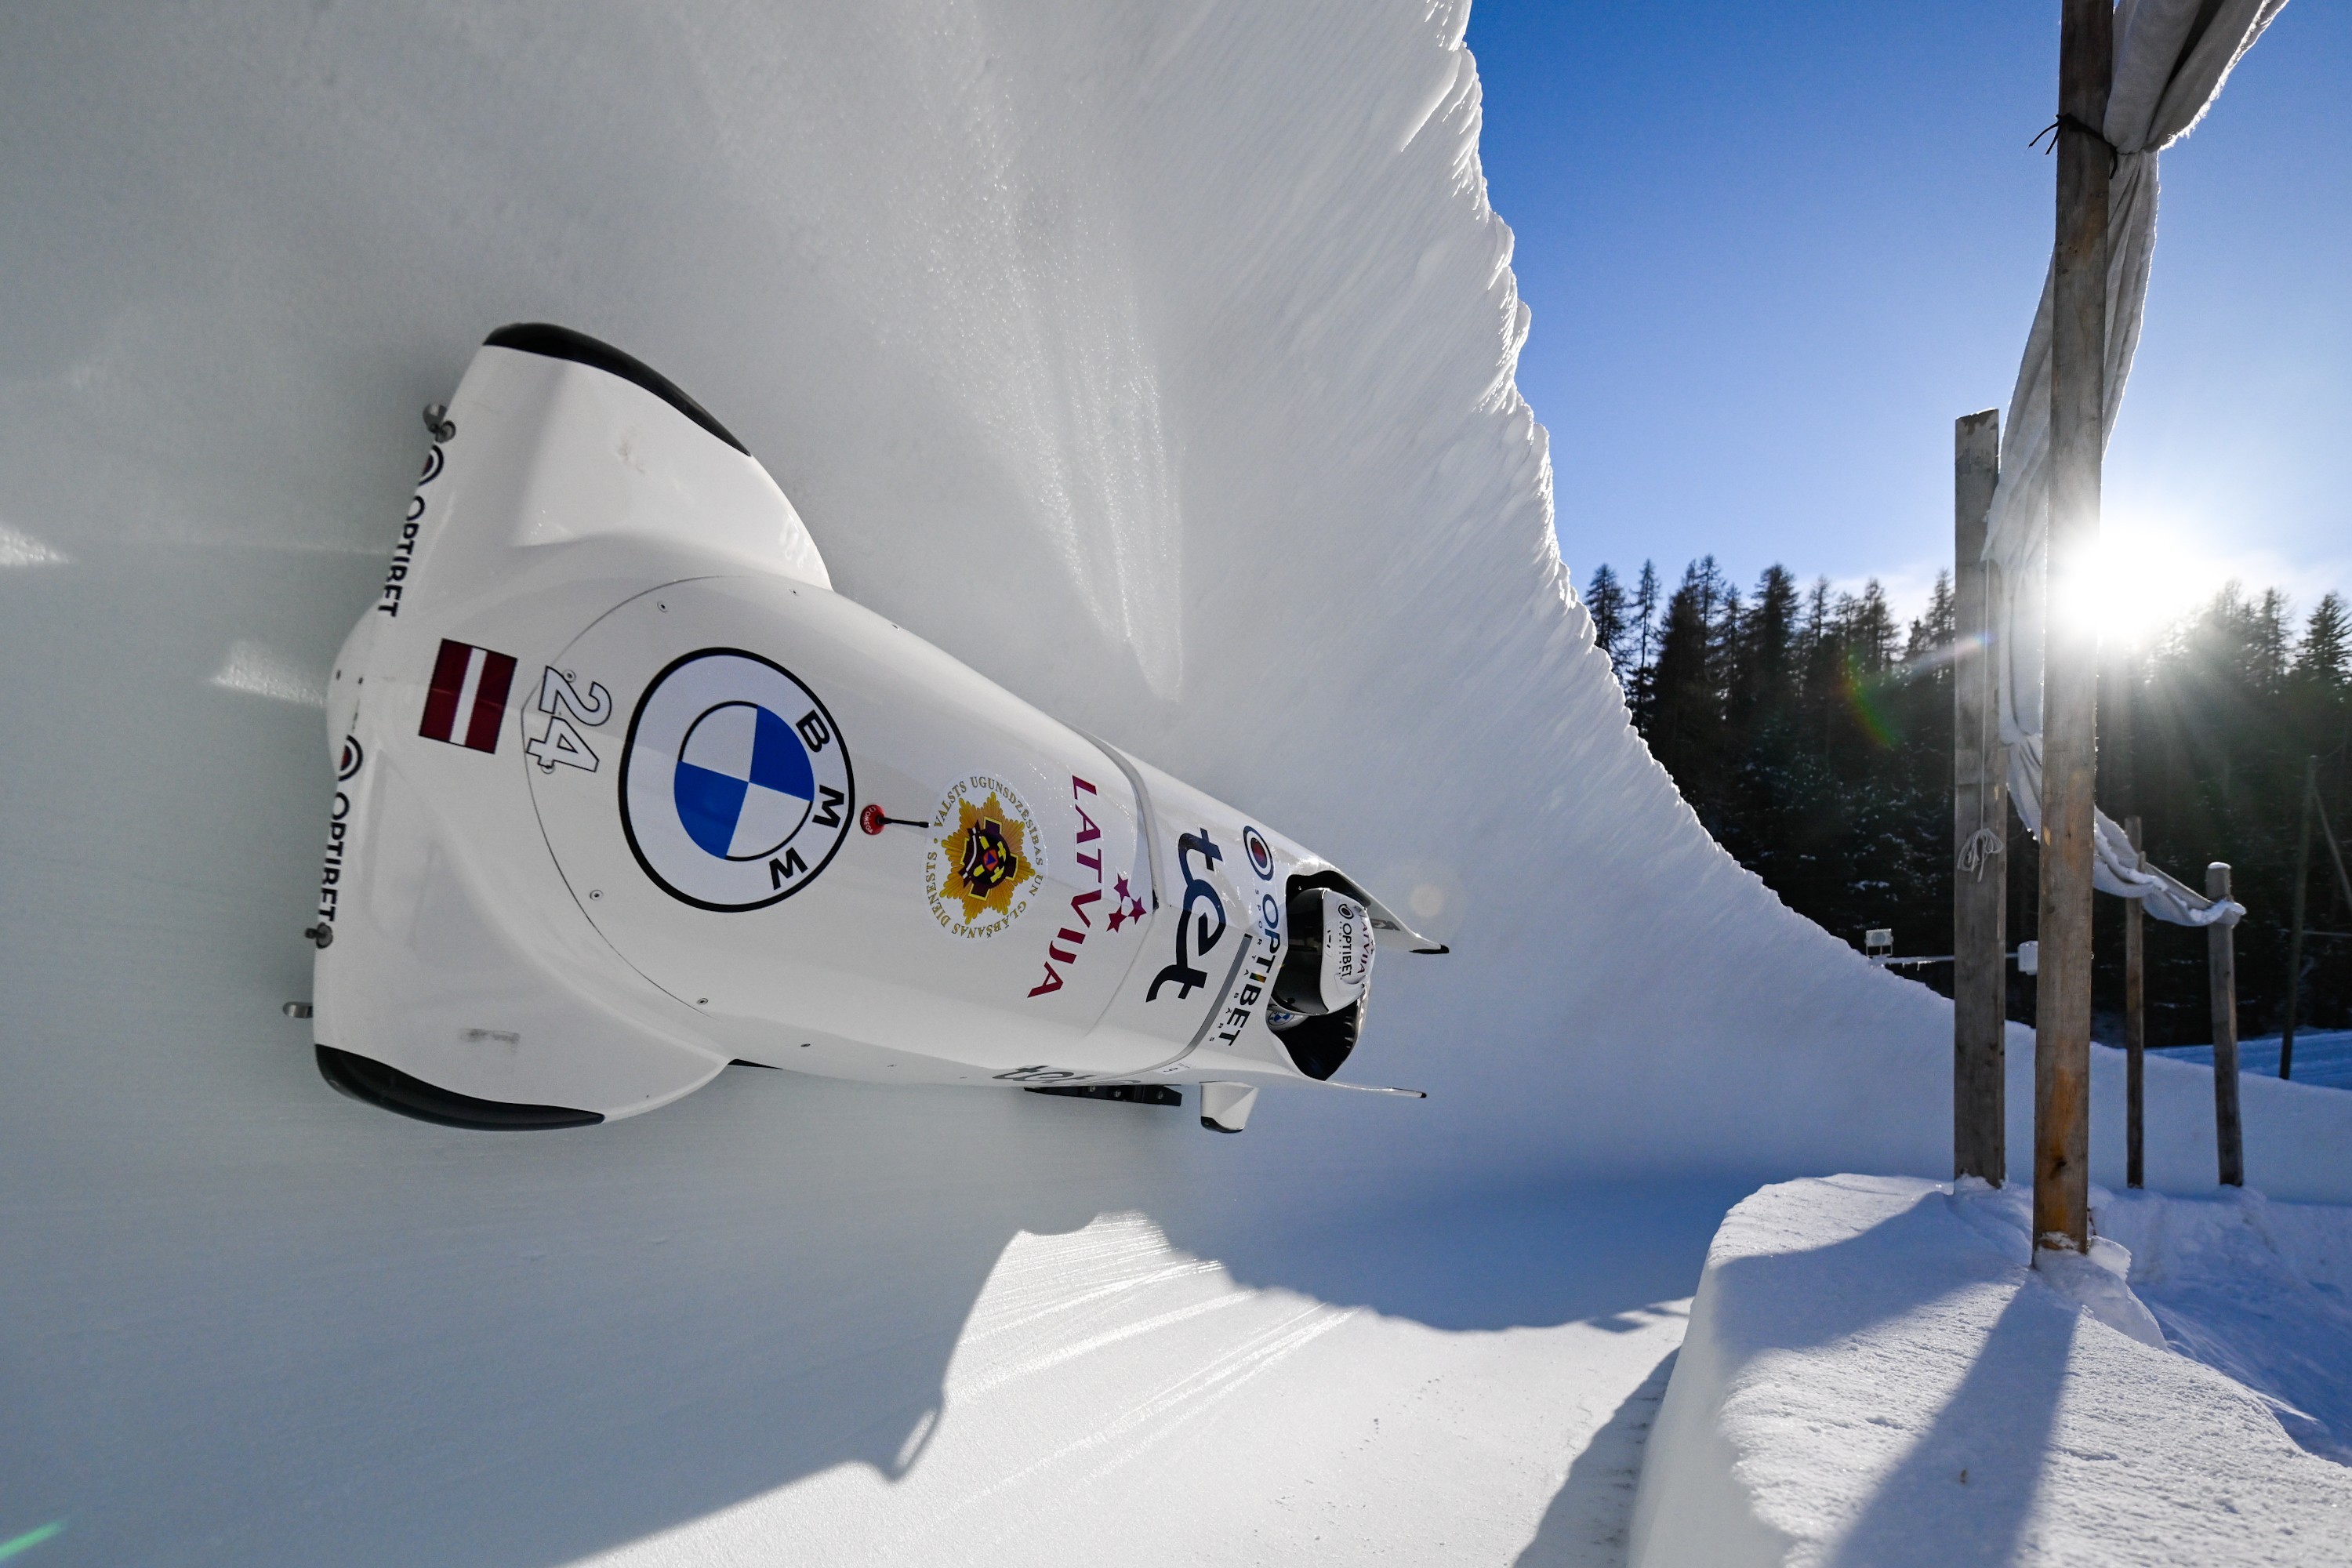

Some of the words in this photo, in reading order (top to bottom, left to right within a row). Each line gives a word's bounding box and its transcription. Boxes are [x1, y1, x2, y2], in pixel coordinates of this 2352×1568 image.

[525, 665, 612, 772] 24
[768, 710, 846, 891] BMW
[863, 811, 873, 833] OMEGA
[934, 780, 967, 829] VALSTS
[318, 791, 350, 922] OPTIBET
[925, 851, 952, 928] DIENESTS
[1026, 775, 1103, 999] LATVIJA
[1028, 873, 1044, 897] UN
[1146, 827, 1226, 1003] tet
[1341, 923, 1352, 978] OPTIBET
[1218, 894, 1281, 1047] OPTIBET
